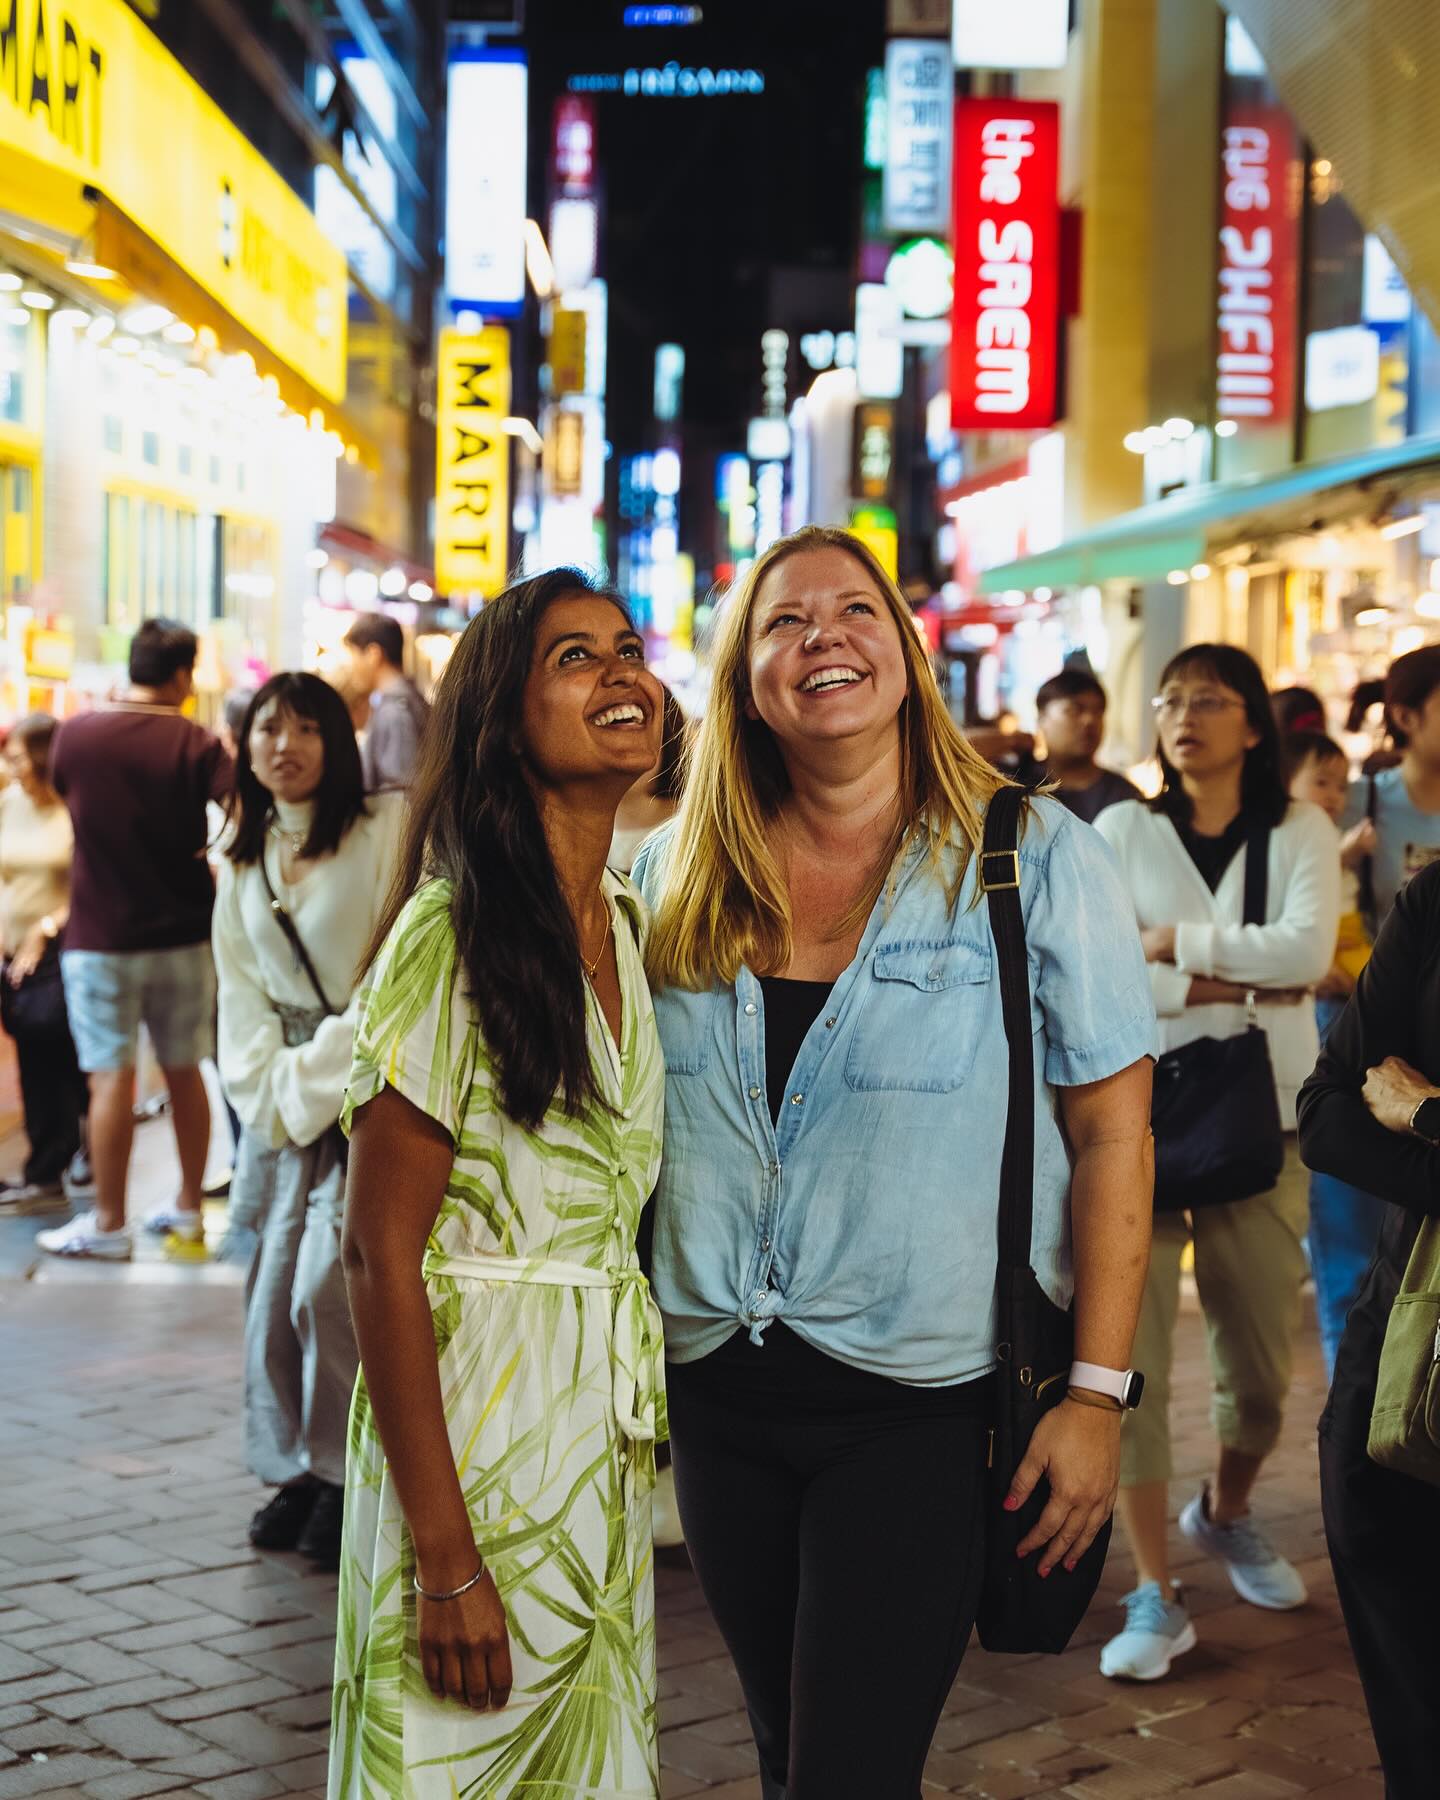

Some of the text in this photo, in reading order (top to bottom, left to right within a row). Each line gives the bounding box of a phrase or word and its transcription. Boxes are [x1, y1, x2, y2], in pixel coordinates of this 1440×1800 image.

[975, 118, 1035, 413] the SAEM
[453, 361, 492, 563] MART
